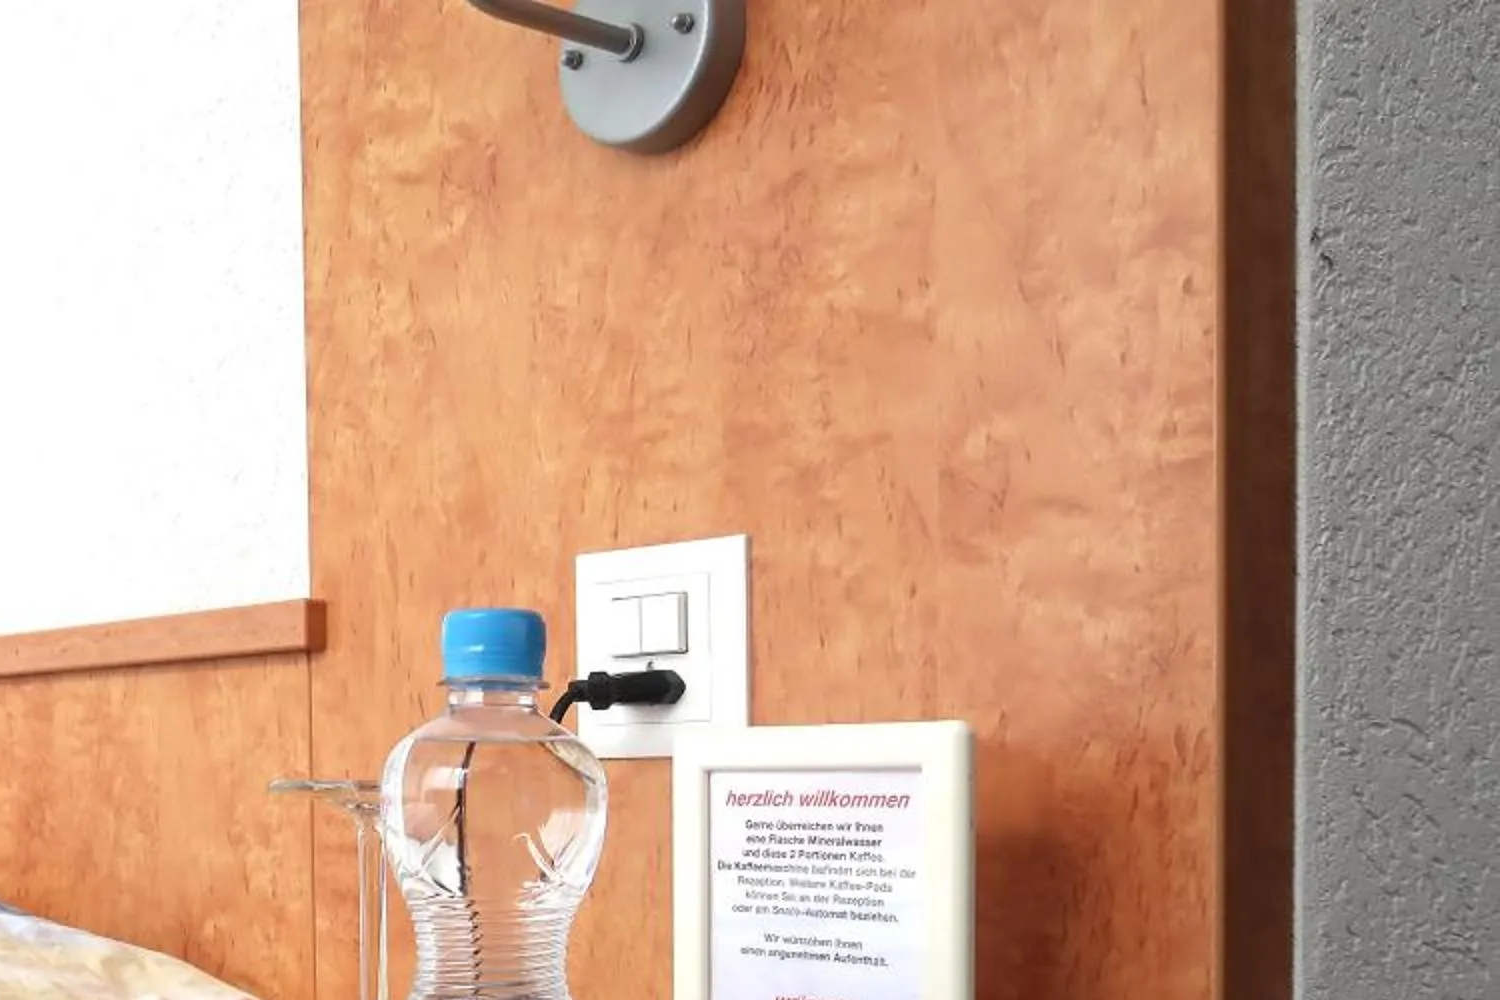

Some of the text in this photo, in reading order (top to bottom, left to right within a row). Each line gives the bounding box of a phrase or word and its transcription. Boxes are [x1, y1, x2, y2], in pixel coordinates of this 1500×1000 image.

[725, 788, 911, 809] herzlich willkommen
[745, 819, 774, 830] Gerne
[836, 822, 852, 832] wir
[745, 833, 882, 847] eine Flasche Mineralwasser
[742, 848, 760, 858] und
[798, 849, 847, 861] Portionen
[717, 859, 733, 871] Die
[764, 933, 780, 943] Wir
